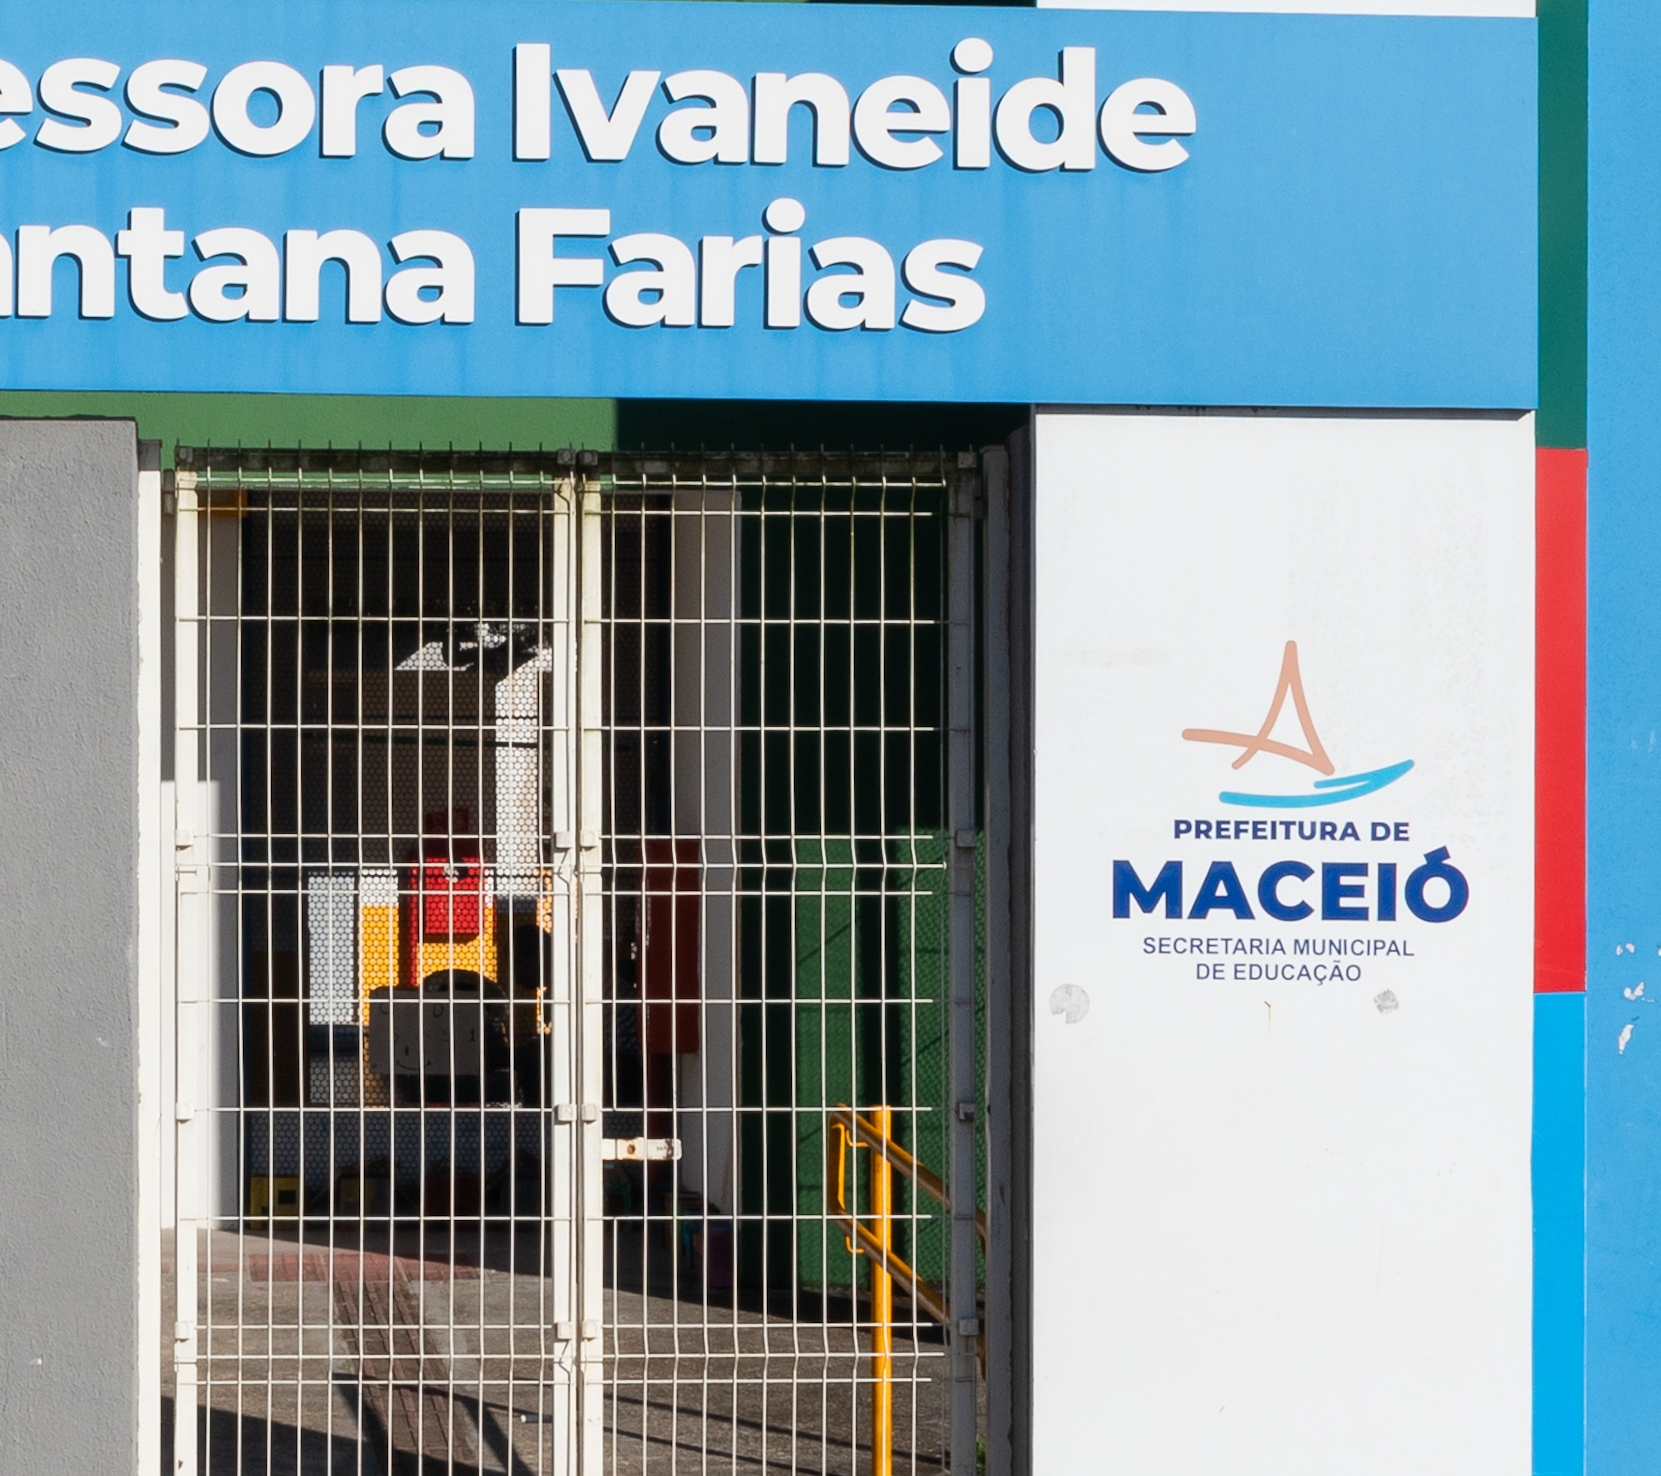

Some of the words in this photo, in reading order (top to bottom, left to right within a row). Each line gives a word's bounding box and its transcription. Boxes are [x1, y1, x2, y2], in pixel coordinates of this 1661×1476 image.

[515, 36, 1199, 173] Ivaneide
[518, 196, 988, 333] Farias
[1174, 819, 1361, 842] PREFEITURA
[1370, 821, 1410, 842] DE
[1112, 845, 1470, 924] MACEIÓ
[1143, 936, 1287, 955] SECRETARIA
[1293, 938, 1415, 957] MUNICIPAL
[1196, 963, 1225, 980] DE
[1233, 960, 1361, 986] EDUCAÇÃO
